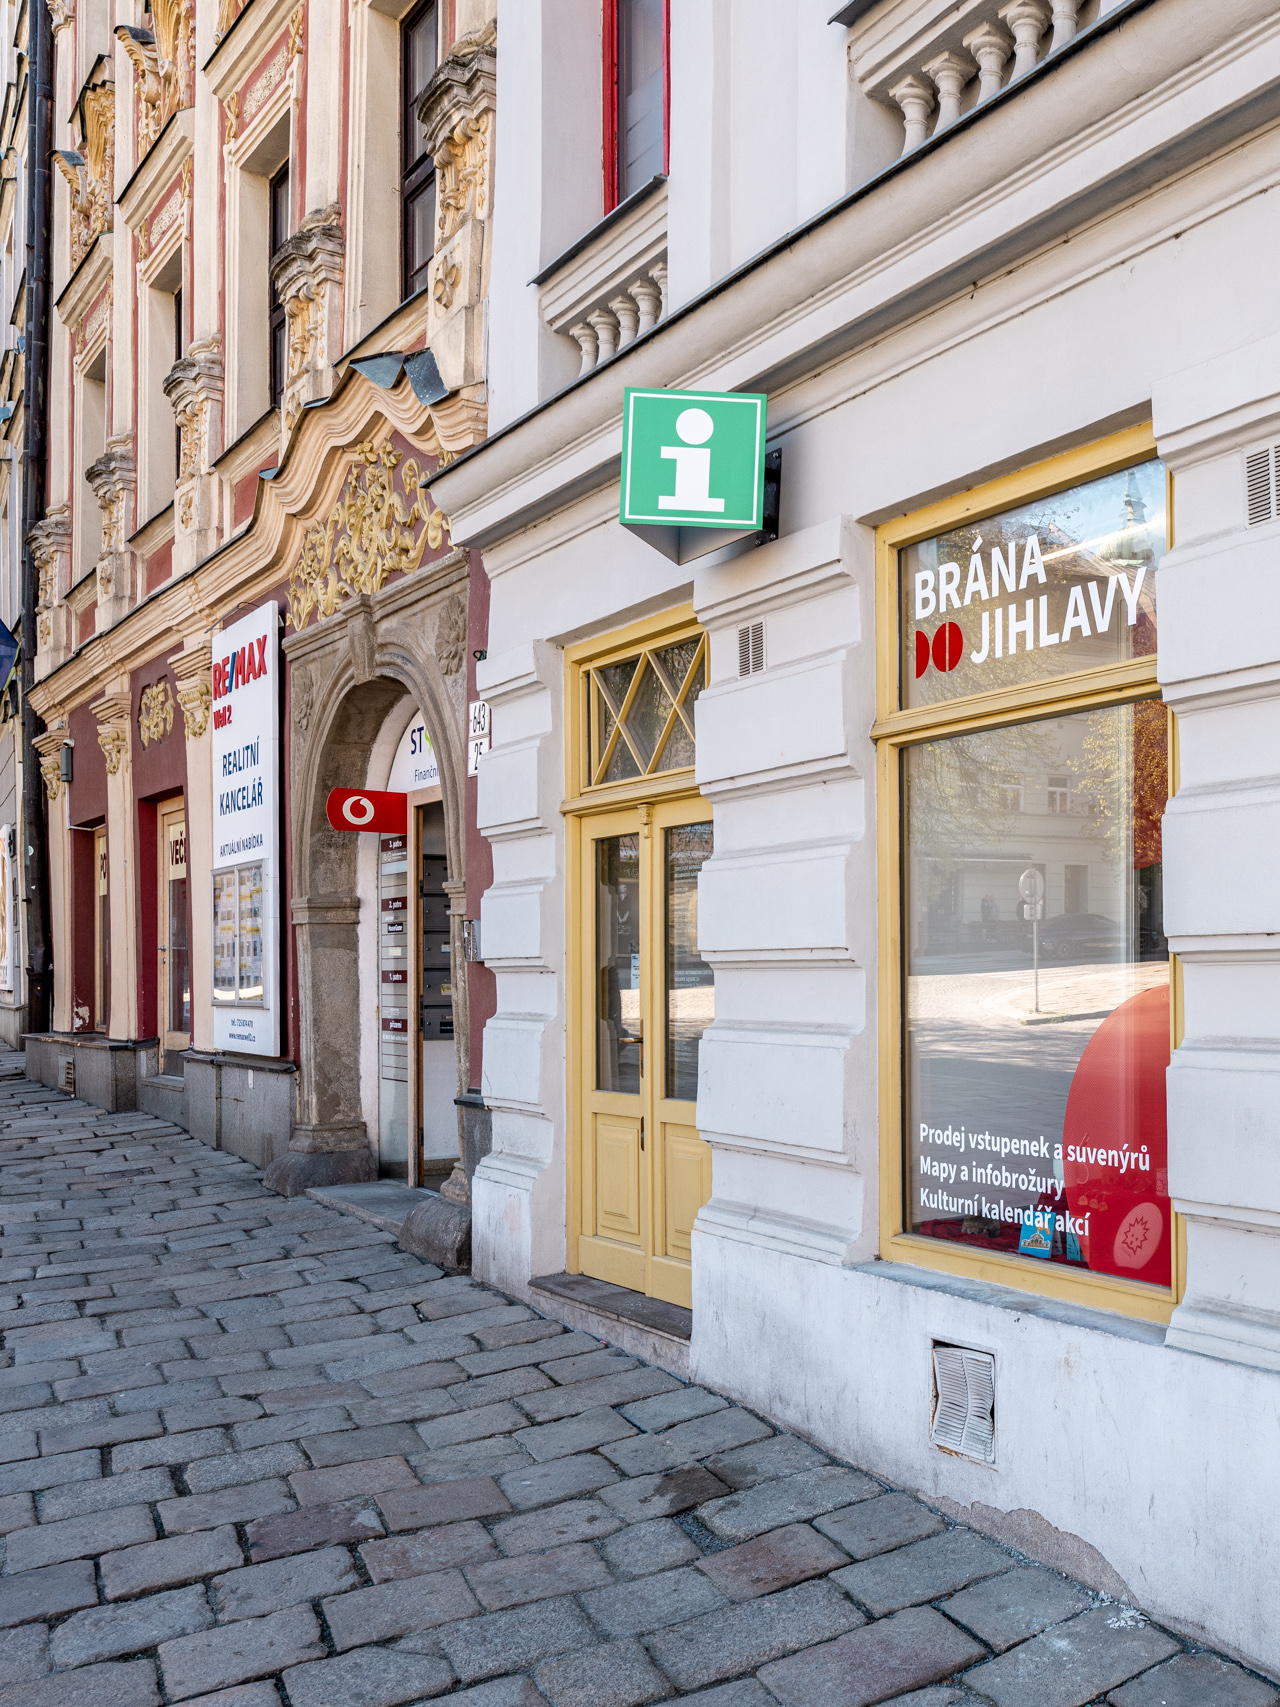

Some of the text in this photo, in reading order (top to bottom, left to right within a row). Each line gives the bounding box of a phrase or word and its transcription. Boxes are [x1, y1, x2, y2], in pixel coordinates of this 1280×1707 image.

[915, 534, 1047, 620] BRÁNA
[970, 566, 1147, 664] JIHLAVY
[213, 634, 267, 700] RE/MAX
[472, 703, 486, 733] 643
[222, 735, 260, 777] REALITNÍ
[220, 776, 263, 816] KANCELÁŘ
[220, 833, 263, 857] AKTUÁLNÍ NABÍDKA
[920, 1123, 1150, 1173] Prodej vstupenek a suvenýrů
[920, 1155, 1065, 1200] Mapy a infobrožury
[920, 1188, 1091, 1236] Kulturní kalendář akcí
